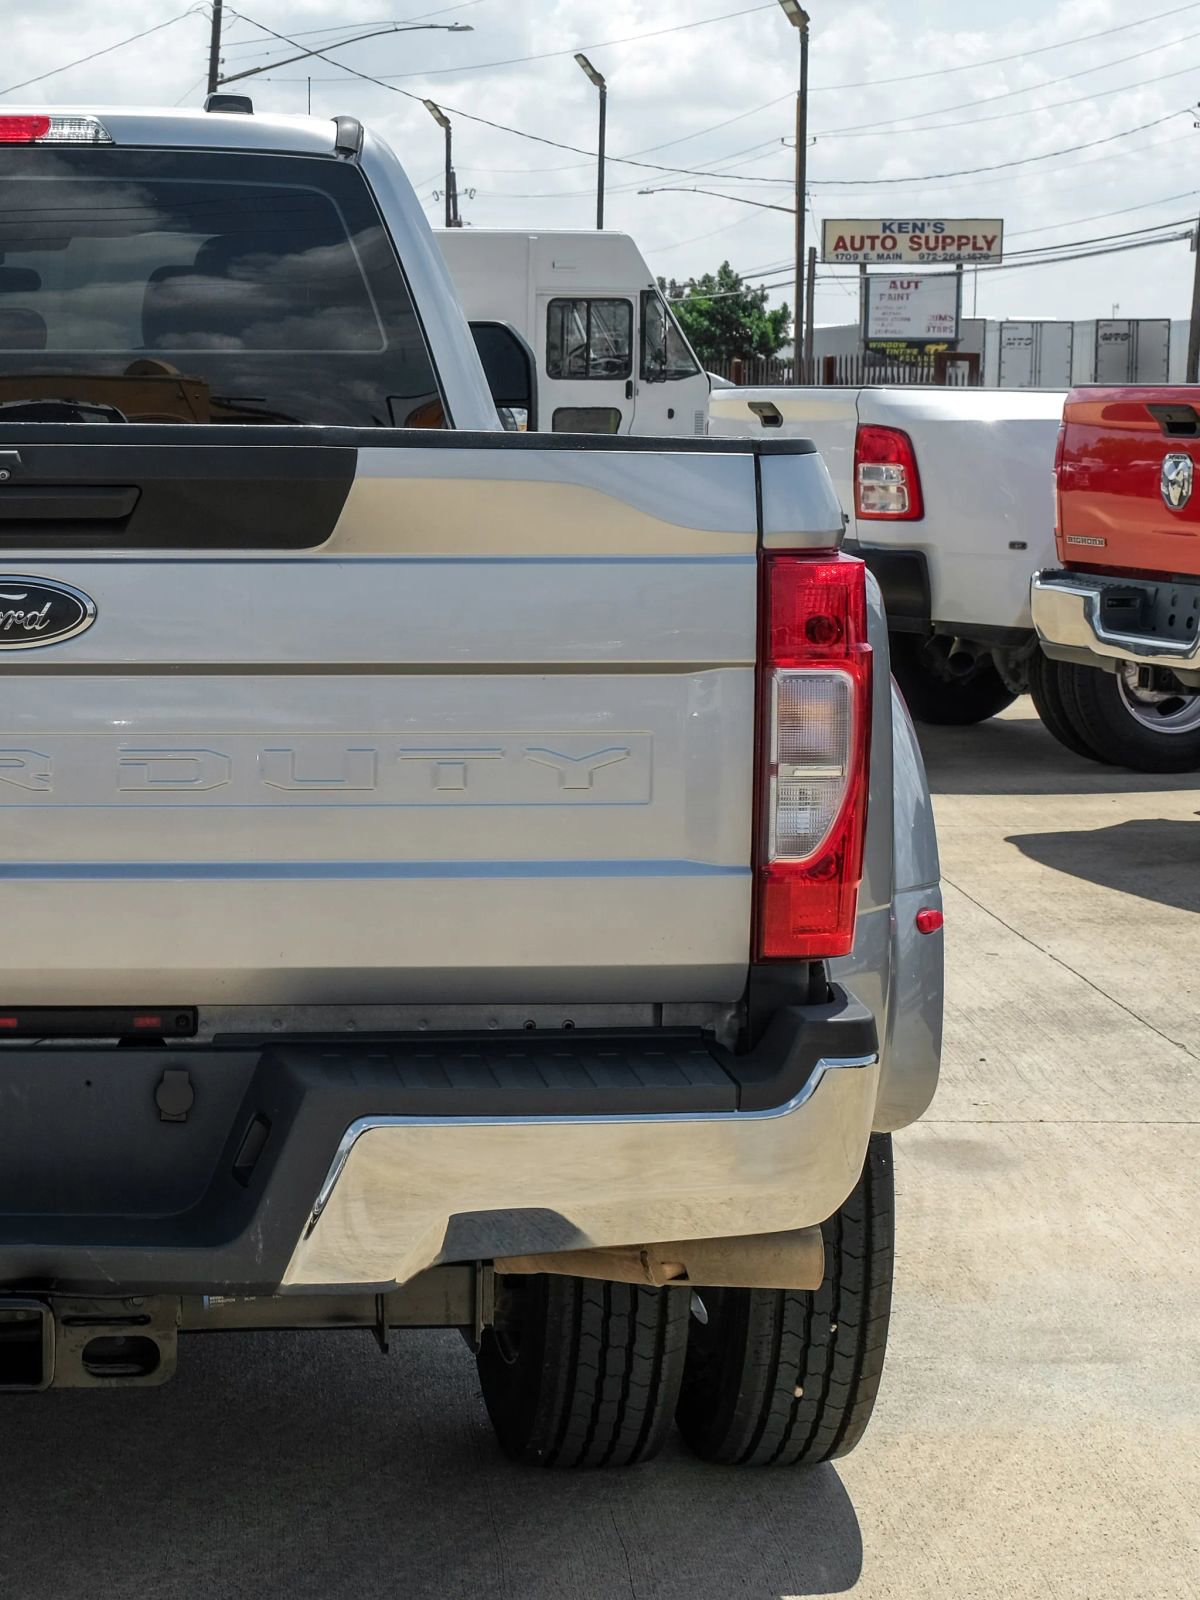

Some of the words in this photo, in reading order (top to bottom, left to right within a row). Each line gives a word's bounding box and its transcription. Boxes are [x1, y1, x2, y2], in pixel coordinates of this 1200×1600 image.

[882, 222, 945, 234] KEN'S
[833, 235, 898, 251] AUTO
[908, 235, 998, 251] SUPPLY
[835, 252, 859, 261] 1709
[863, 252, 873, 261] E.
[877, 252, 903, 261] MAIN
[117, 746, 631, 792] DUTY
